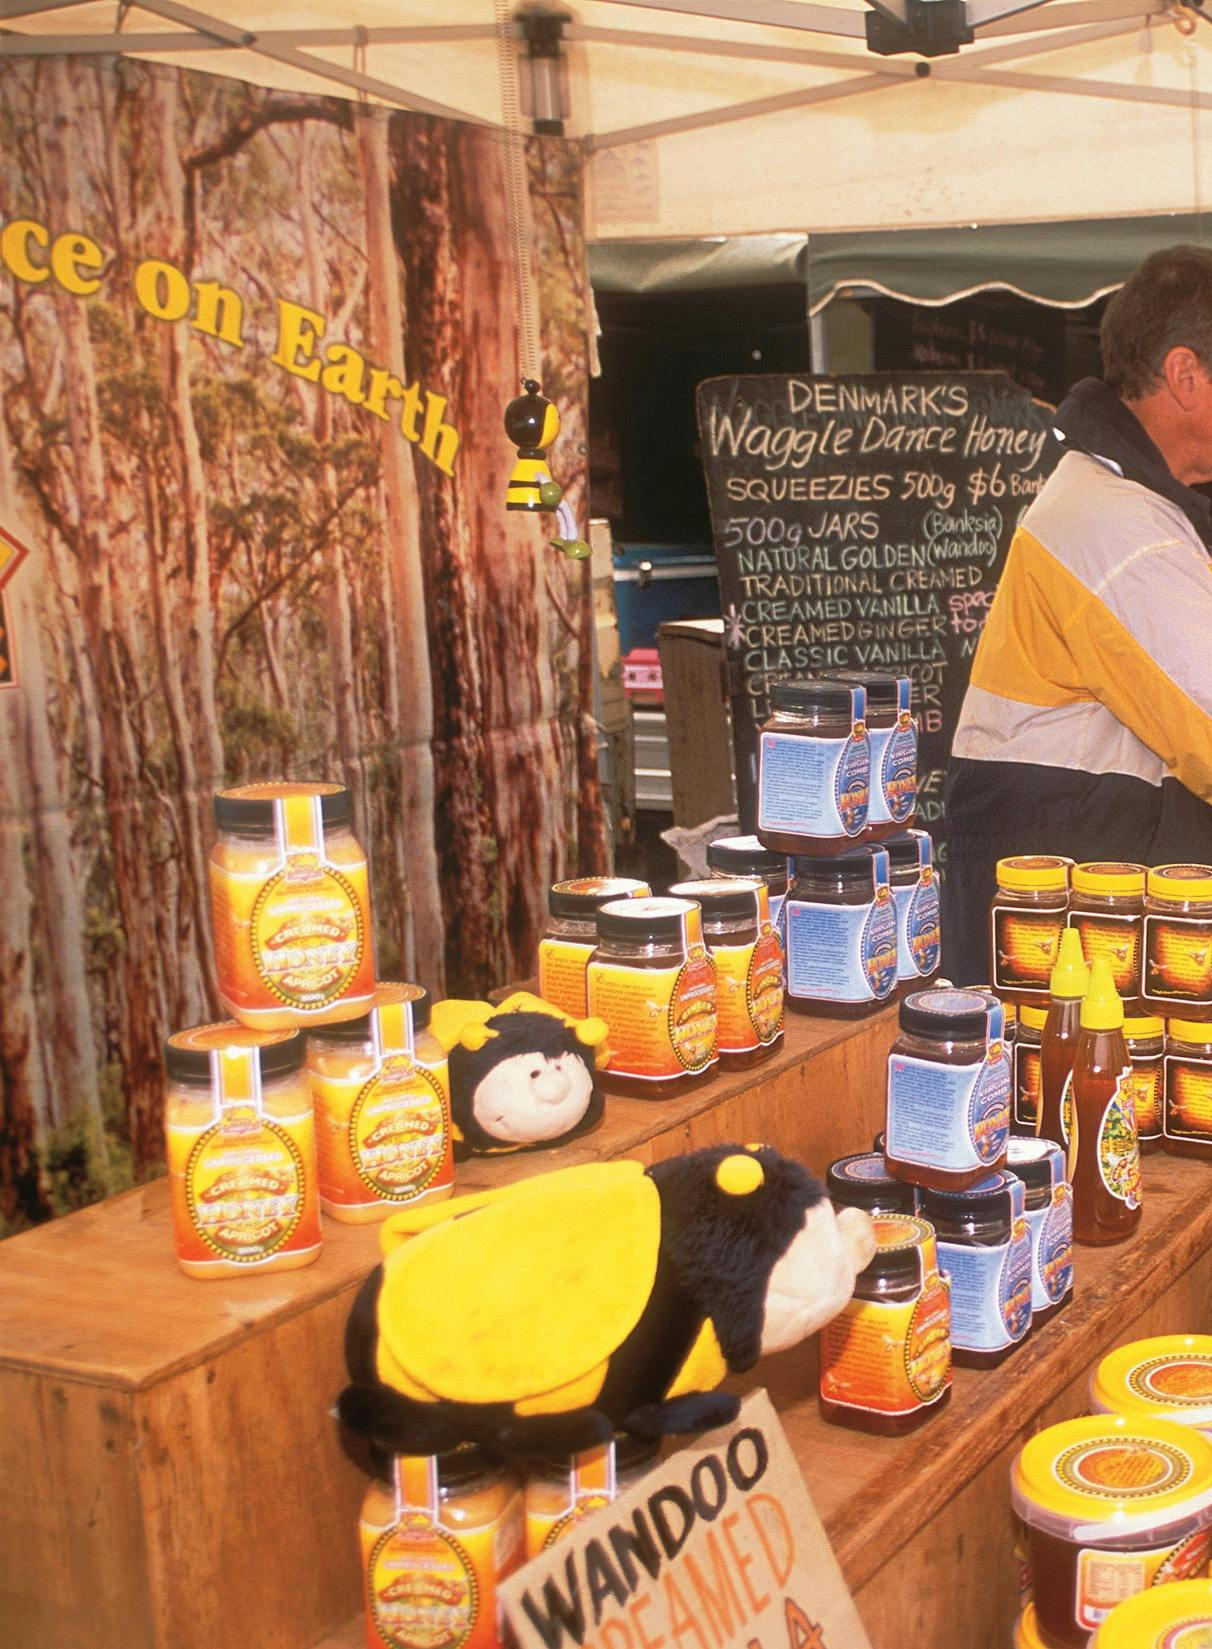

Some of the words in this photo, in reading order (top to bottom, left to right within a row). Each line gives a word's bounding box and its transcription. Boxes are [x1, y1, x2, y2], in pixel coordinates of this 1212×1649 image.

[134, 258, 244, 350] on
[270, 299, 460, 478] Earth
[788, 379, 968, 417] DENMARK'S
[709, 406, 853, 471] Waggle
[860, 416, 957, 454] Dance
[963, 415, 1047, 472] Honey
[726, 474, 895, 503] SQUEEZIES
[901, 470, 956, 509] 500g
[967, 462, 1007, 506] $6
[723, 516, 803, 551] 500g
[808, 511, 881, 541] JARS
[738, 547, 838, 575] NATURAL
[840, 545, 928, 571] GOLDEN
[740, 572, 883, 599] TRADITIONAL
[889, 566, 983, 595] CREAMED
[741, 599, 852, 625] CREAMED
[855, 594, 941, 620] VANILLA
[744, 623, 855, 650] CREAMED
[857, 616, 948, 640] GINGER
[742, 643, 850, 672] CLASSIC
[855, 638, 946, 665] VANILLA
[273, 922, 342, 941] CREAMED
[281, 967, 340, 990] APRICOT
[371, 1119, 430, 1143] CREAMED
[210, 1176, 281, 1196] CREAMED
[378, 1160, 429, 1181] APRICOT
[197, 1194, 298, 1226] HONEY
[218, 1221, 278, 1240] APRICOT
[520, 1427, 769, 1649] WANDOO
[580, 1492, 794, 1649] REAMED
